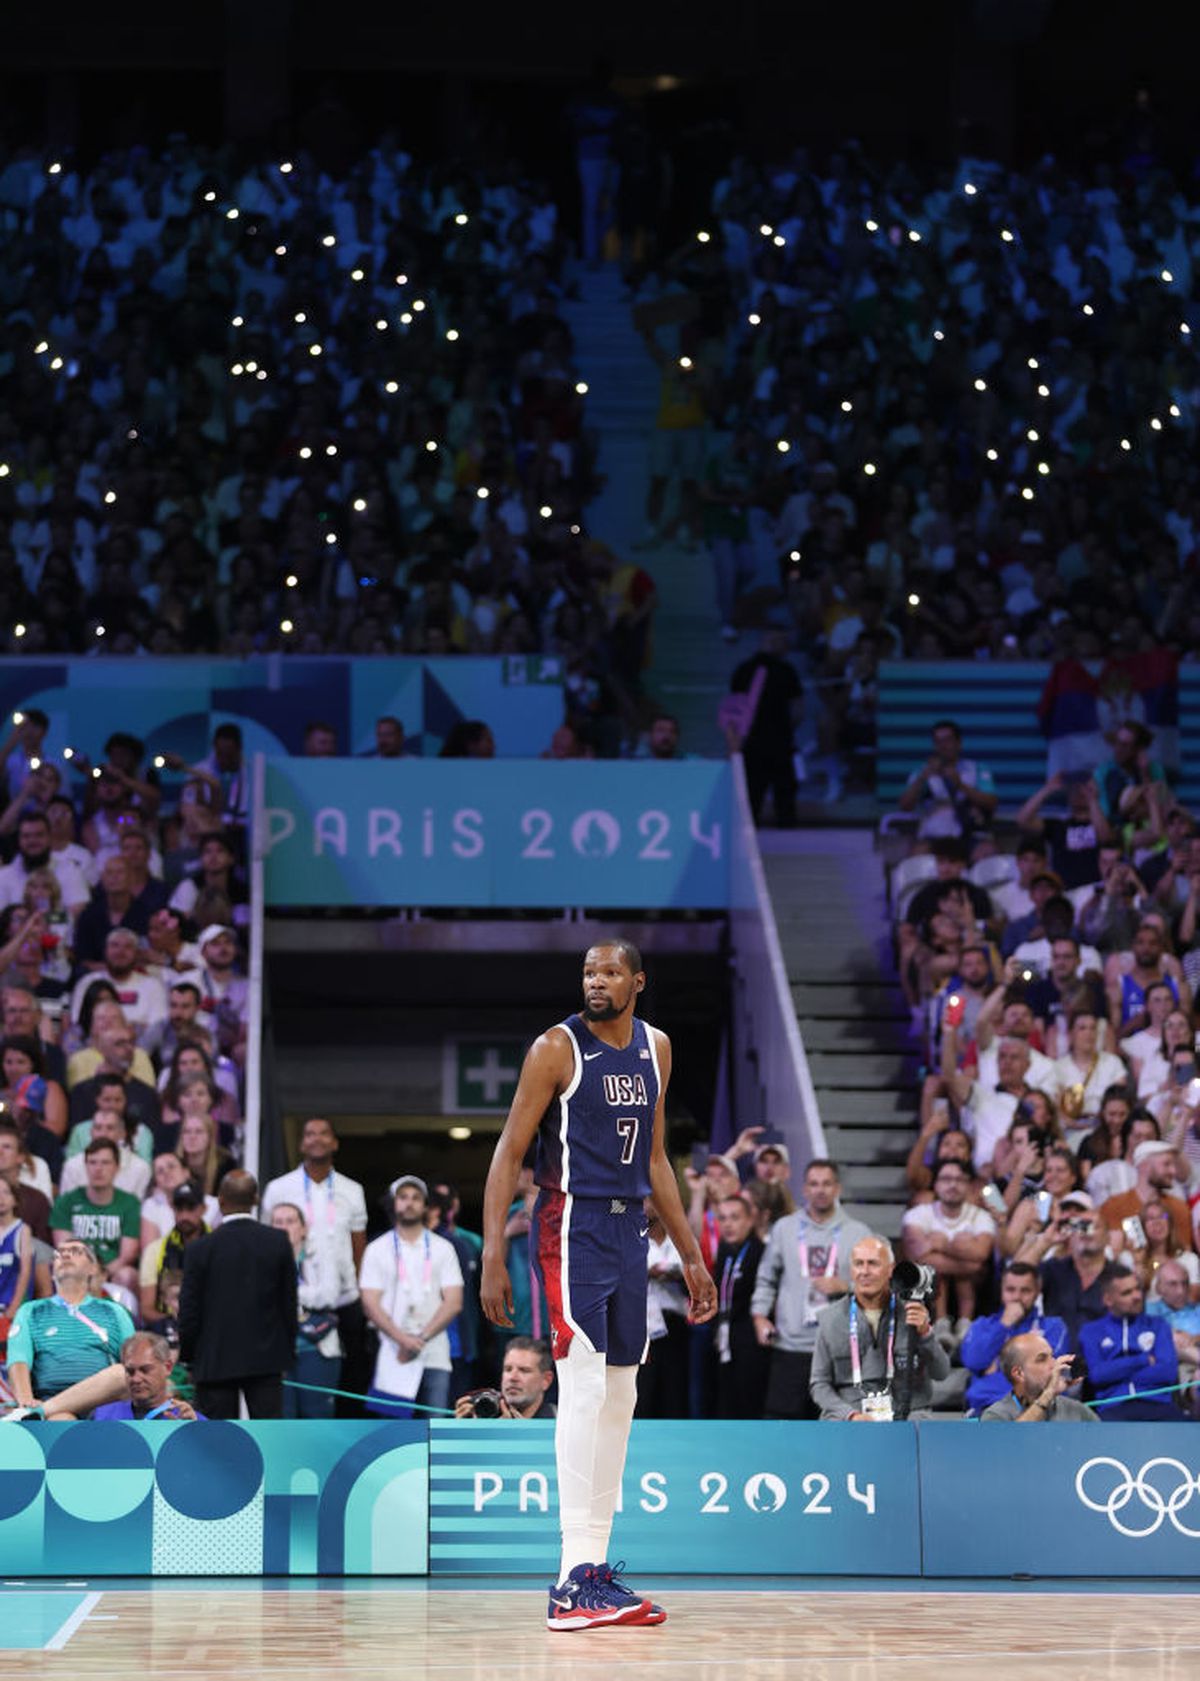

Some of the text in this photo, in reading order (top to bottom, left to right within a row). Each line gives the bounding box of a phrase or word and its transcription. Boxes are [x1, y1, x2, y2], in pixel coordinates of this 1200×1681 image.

[520, 809, 722, 859] 2024
[603, 1074, 648, 1106] USA
[617, 1117, 639, 1164] 7
[474, 1471, 876, 1514] PAS 2024
